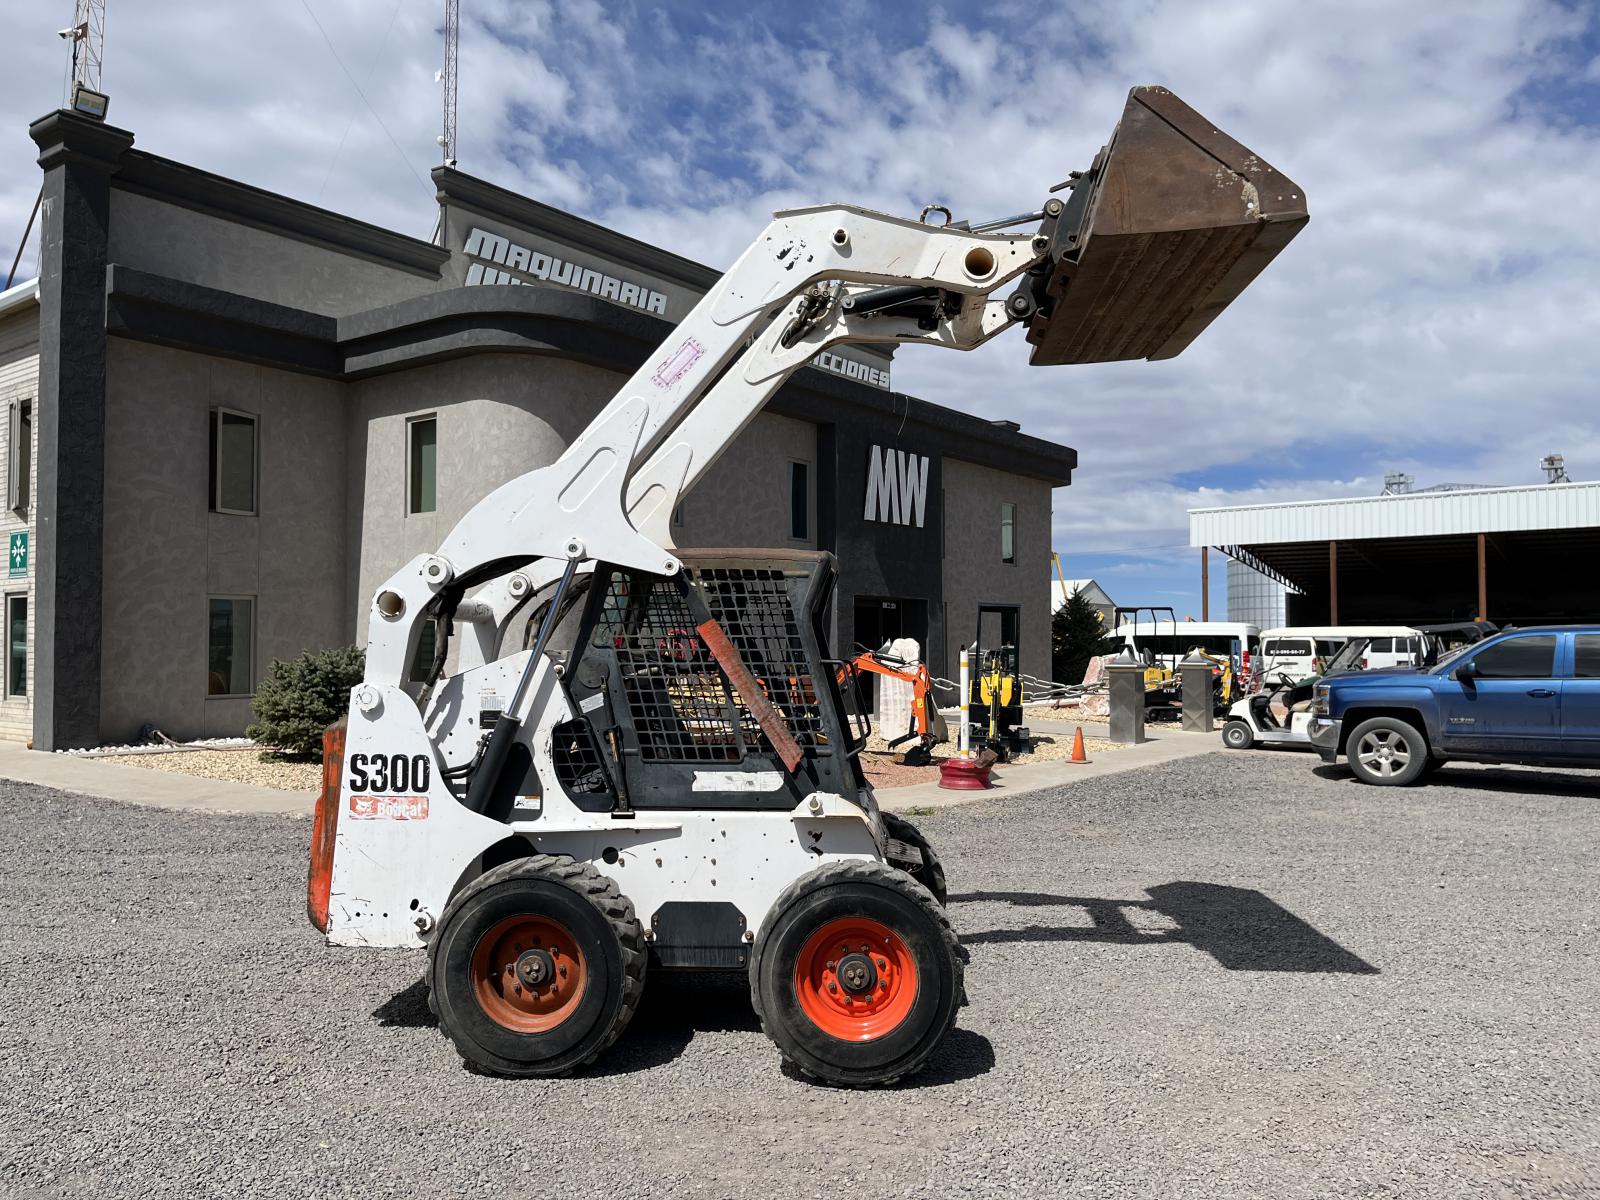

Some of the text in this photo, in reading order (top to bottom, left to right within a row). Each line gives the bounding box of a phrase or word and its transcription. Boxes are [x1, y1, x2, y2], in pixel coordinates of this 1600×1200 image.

[463, 227, 668, 315] MAQUINARIA
[863, 444, 930, 529] MW
[349, 753, 431, 793] S300
